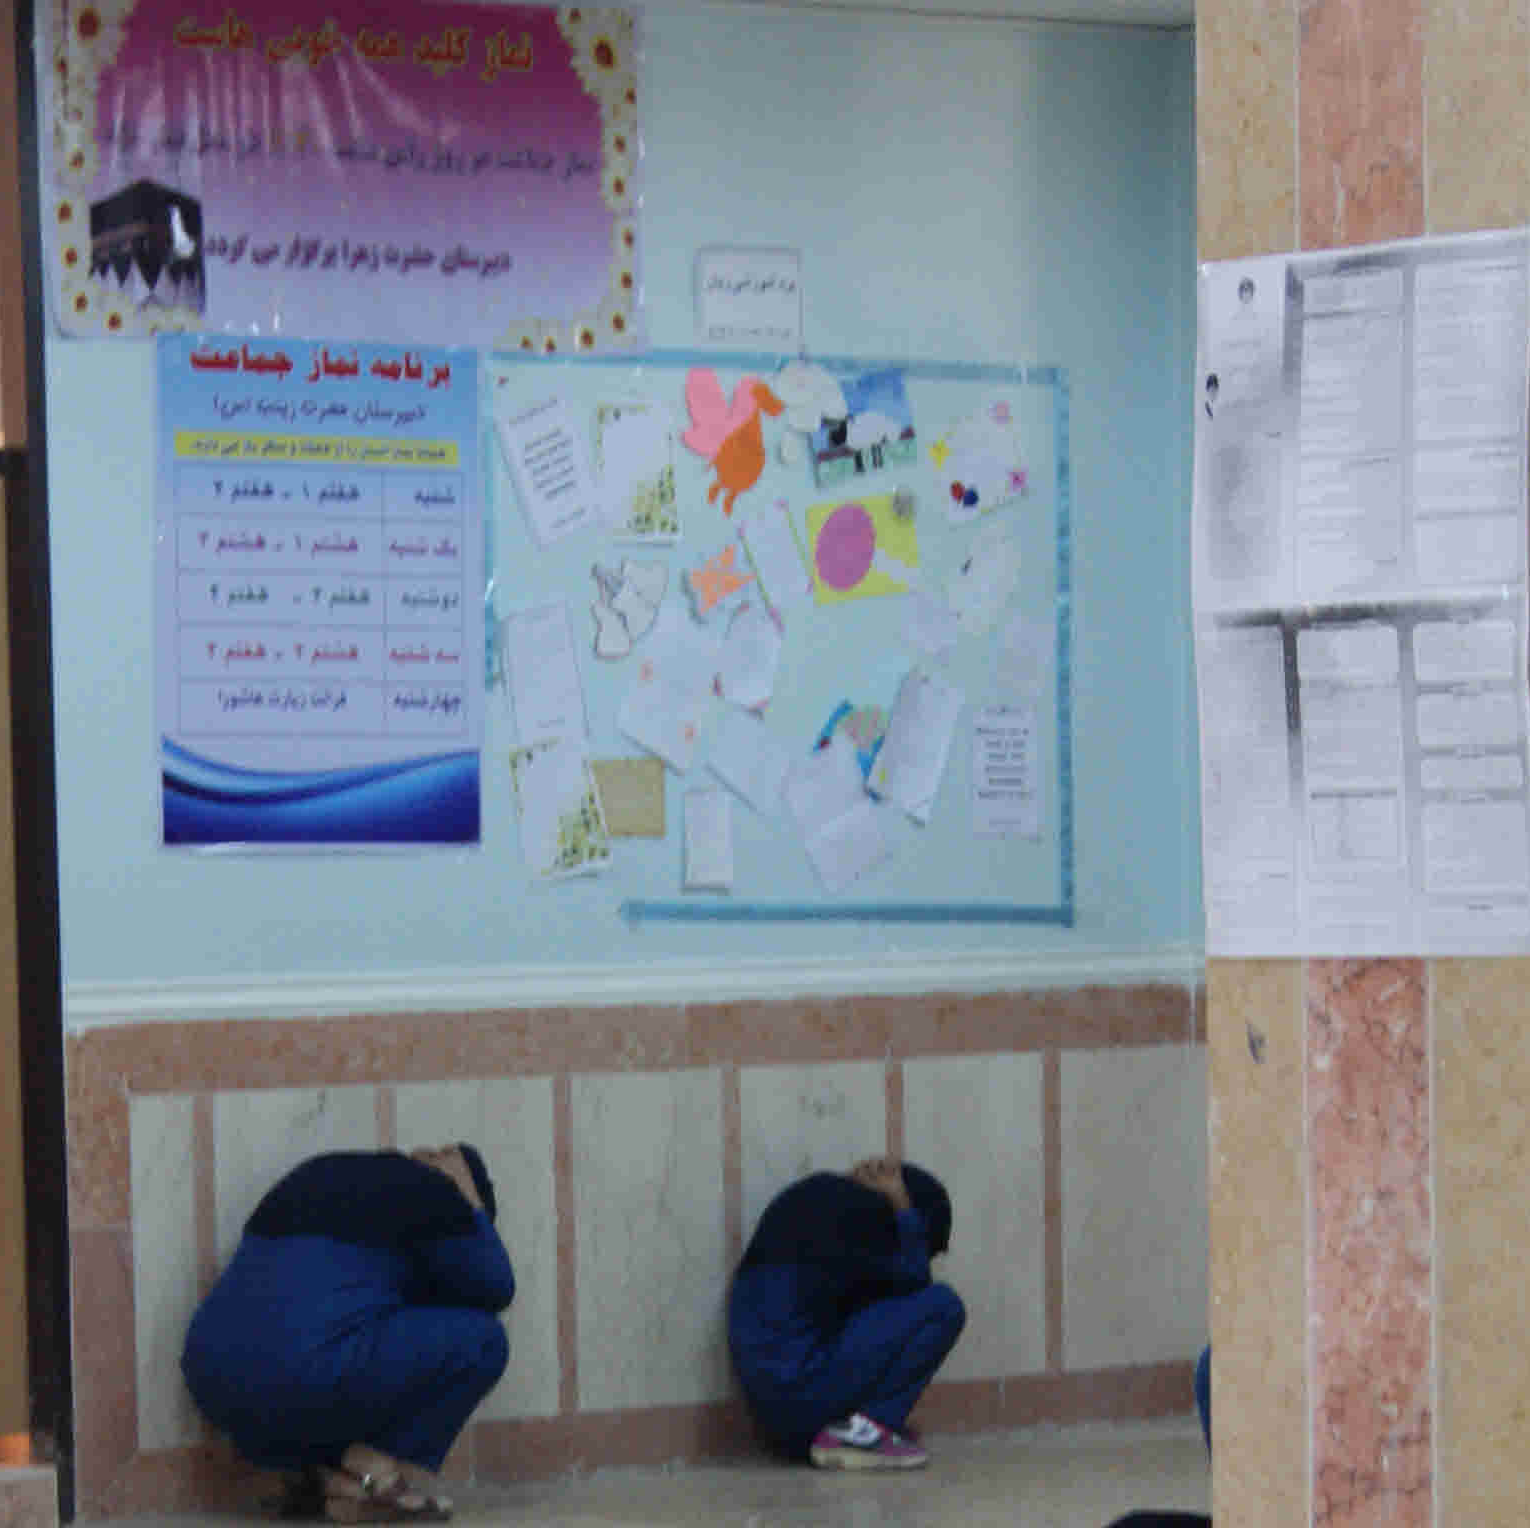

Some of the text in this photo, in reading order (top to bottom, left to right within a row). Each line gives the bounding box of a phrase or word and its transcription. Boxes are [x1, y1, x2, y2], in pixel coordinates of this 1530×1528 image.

[414, 25, 471, 77] کلید
[481, 28, 535, 82] نماز
[190, 343, 452, 390] برنامه نماز جماعت
[353, 400, 428, 428] دبیرستان
[414, 483, 455, 508] شنبه
[390, 536, 429, 560] شنبه
[390, 642, 430, 667] شنبه
